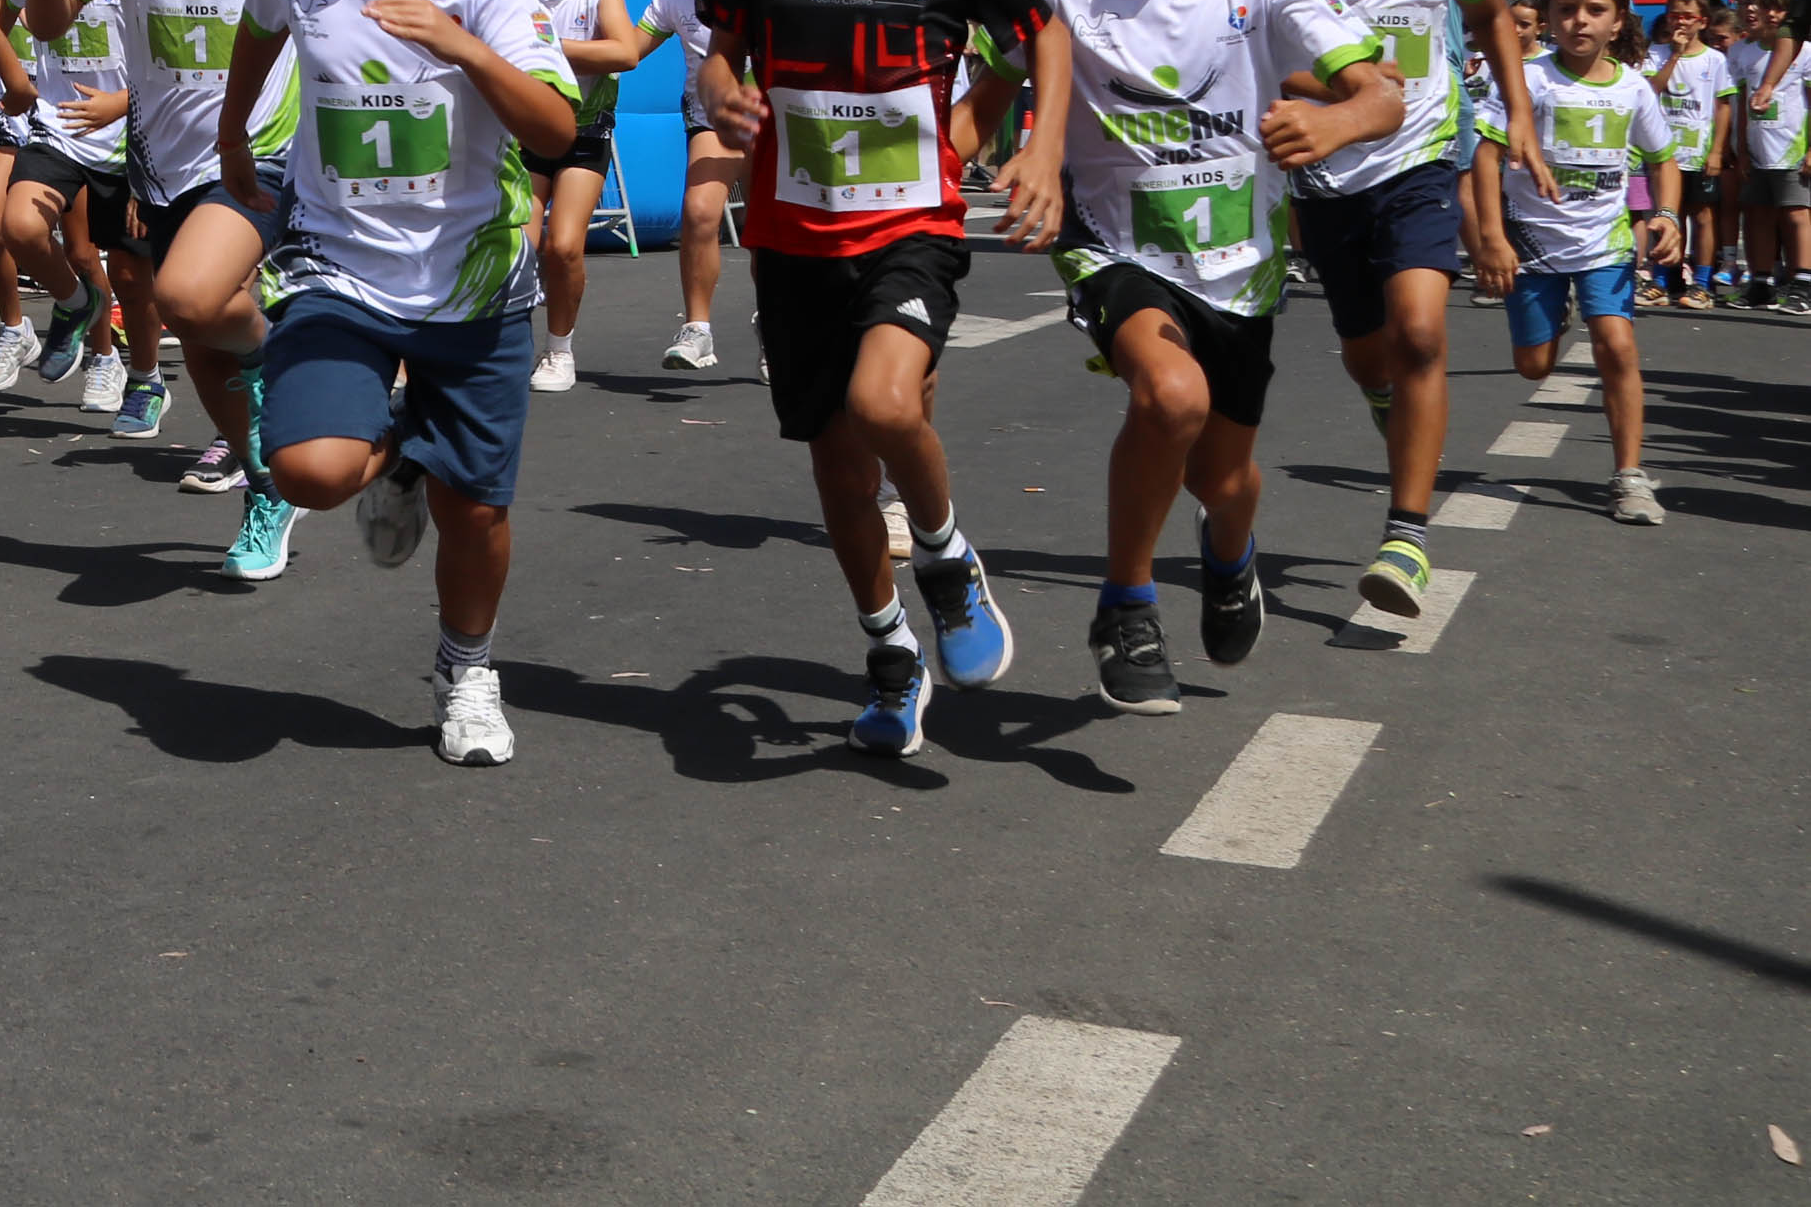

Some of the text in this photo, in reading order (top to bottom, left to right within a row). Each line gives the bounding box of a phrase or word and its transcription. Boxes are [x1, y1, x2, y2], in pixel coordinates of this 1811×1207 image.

[186, 4, 219, 16] KIDS
[1377, 15, 1410, 26] KIDS
[65, 26, 80, 54] 1
[184, 25, 207, 63] 1
[361, 95, 405, 108] KIDS
[832, 105, 876, 118] KIDS
[1586, 99, 1613, 107] KIDS
[1585, 113, 1605, 143] 1
[361, 120, 393, 169] 1
[831, 130, 860, 177] 1
[1182, 170, 1224, 186] KIDS
[1183, 196, 1211, 244] 1
